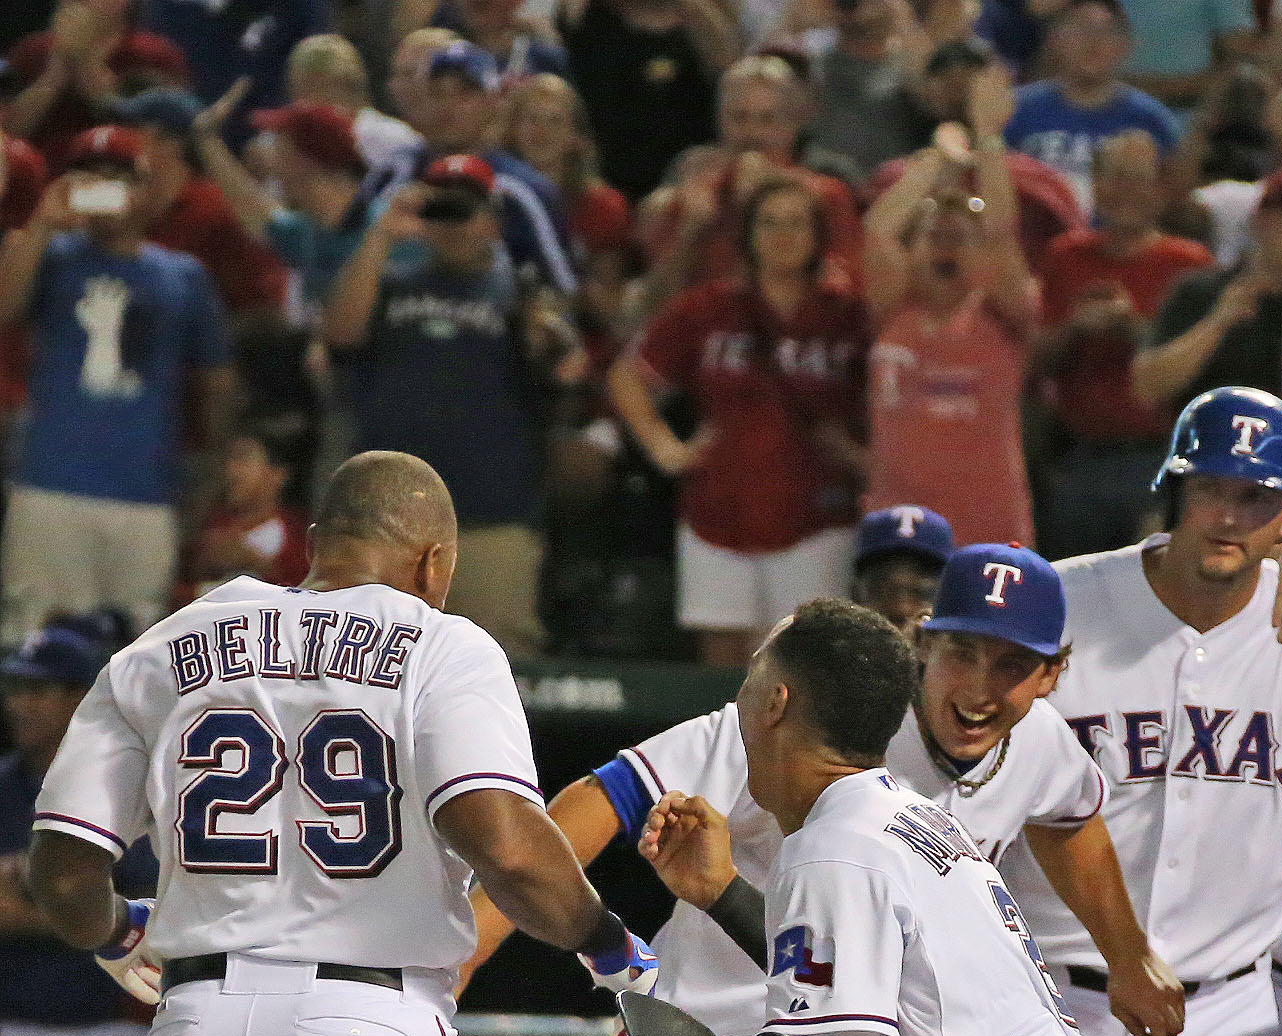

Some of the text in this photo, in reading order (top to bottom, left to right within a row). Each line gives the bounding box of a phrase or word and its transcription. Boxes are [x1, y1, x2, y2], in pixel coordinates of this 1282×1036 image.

[1231, 414, 1268, 455] T
[891, 503, 925, 538] T
[981, 561, 1024, 608] T
[169, 608, 422, 697] BELTRE
[175, 708, 404, 880] 29
